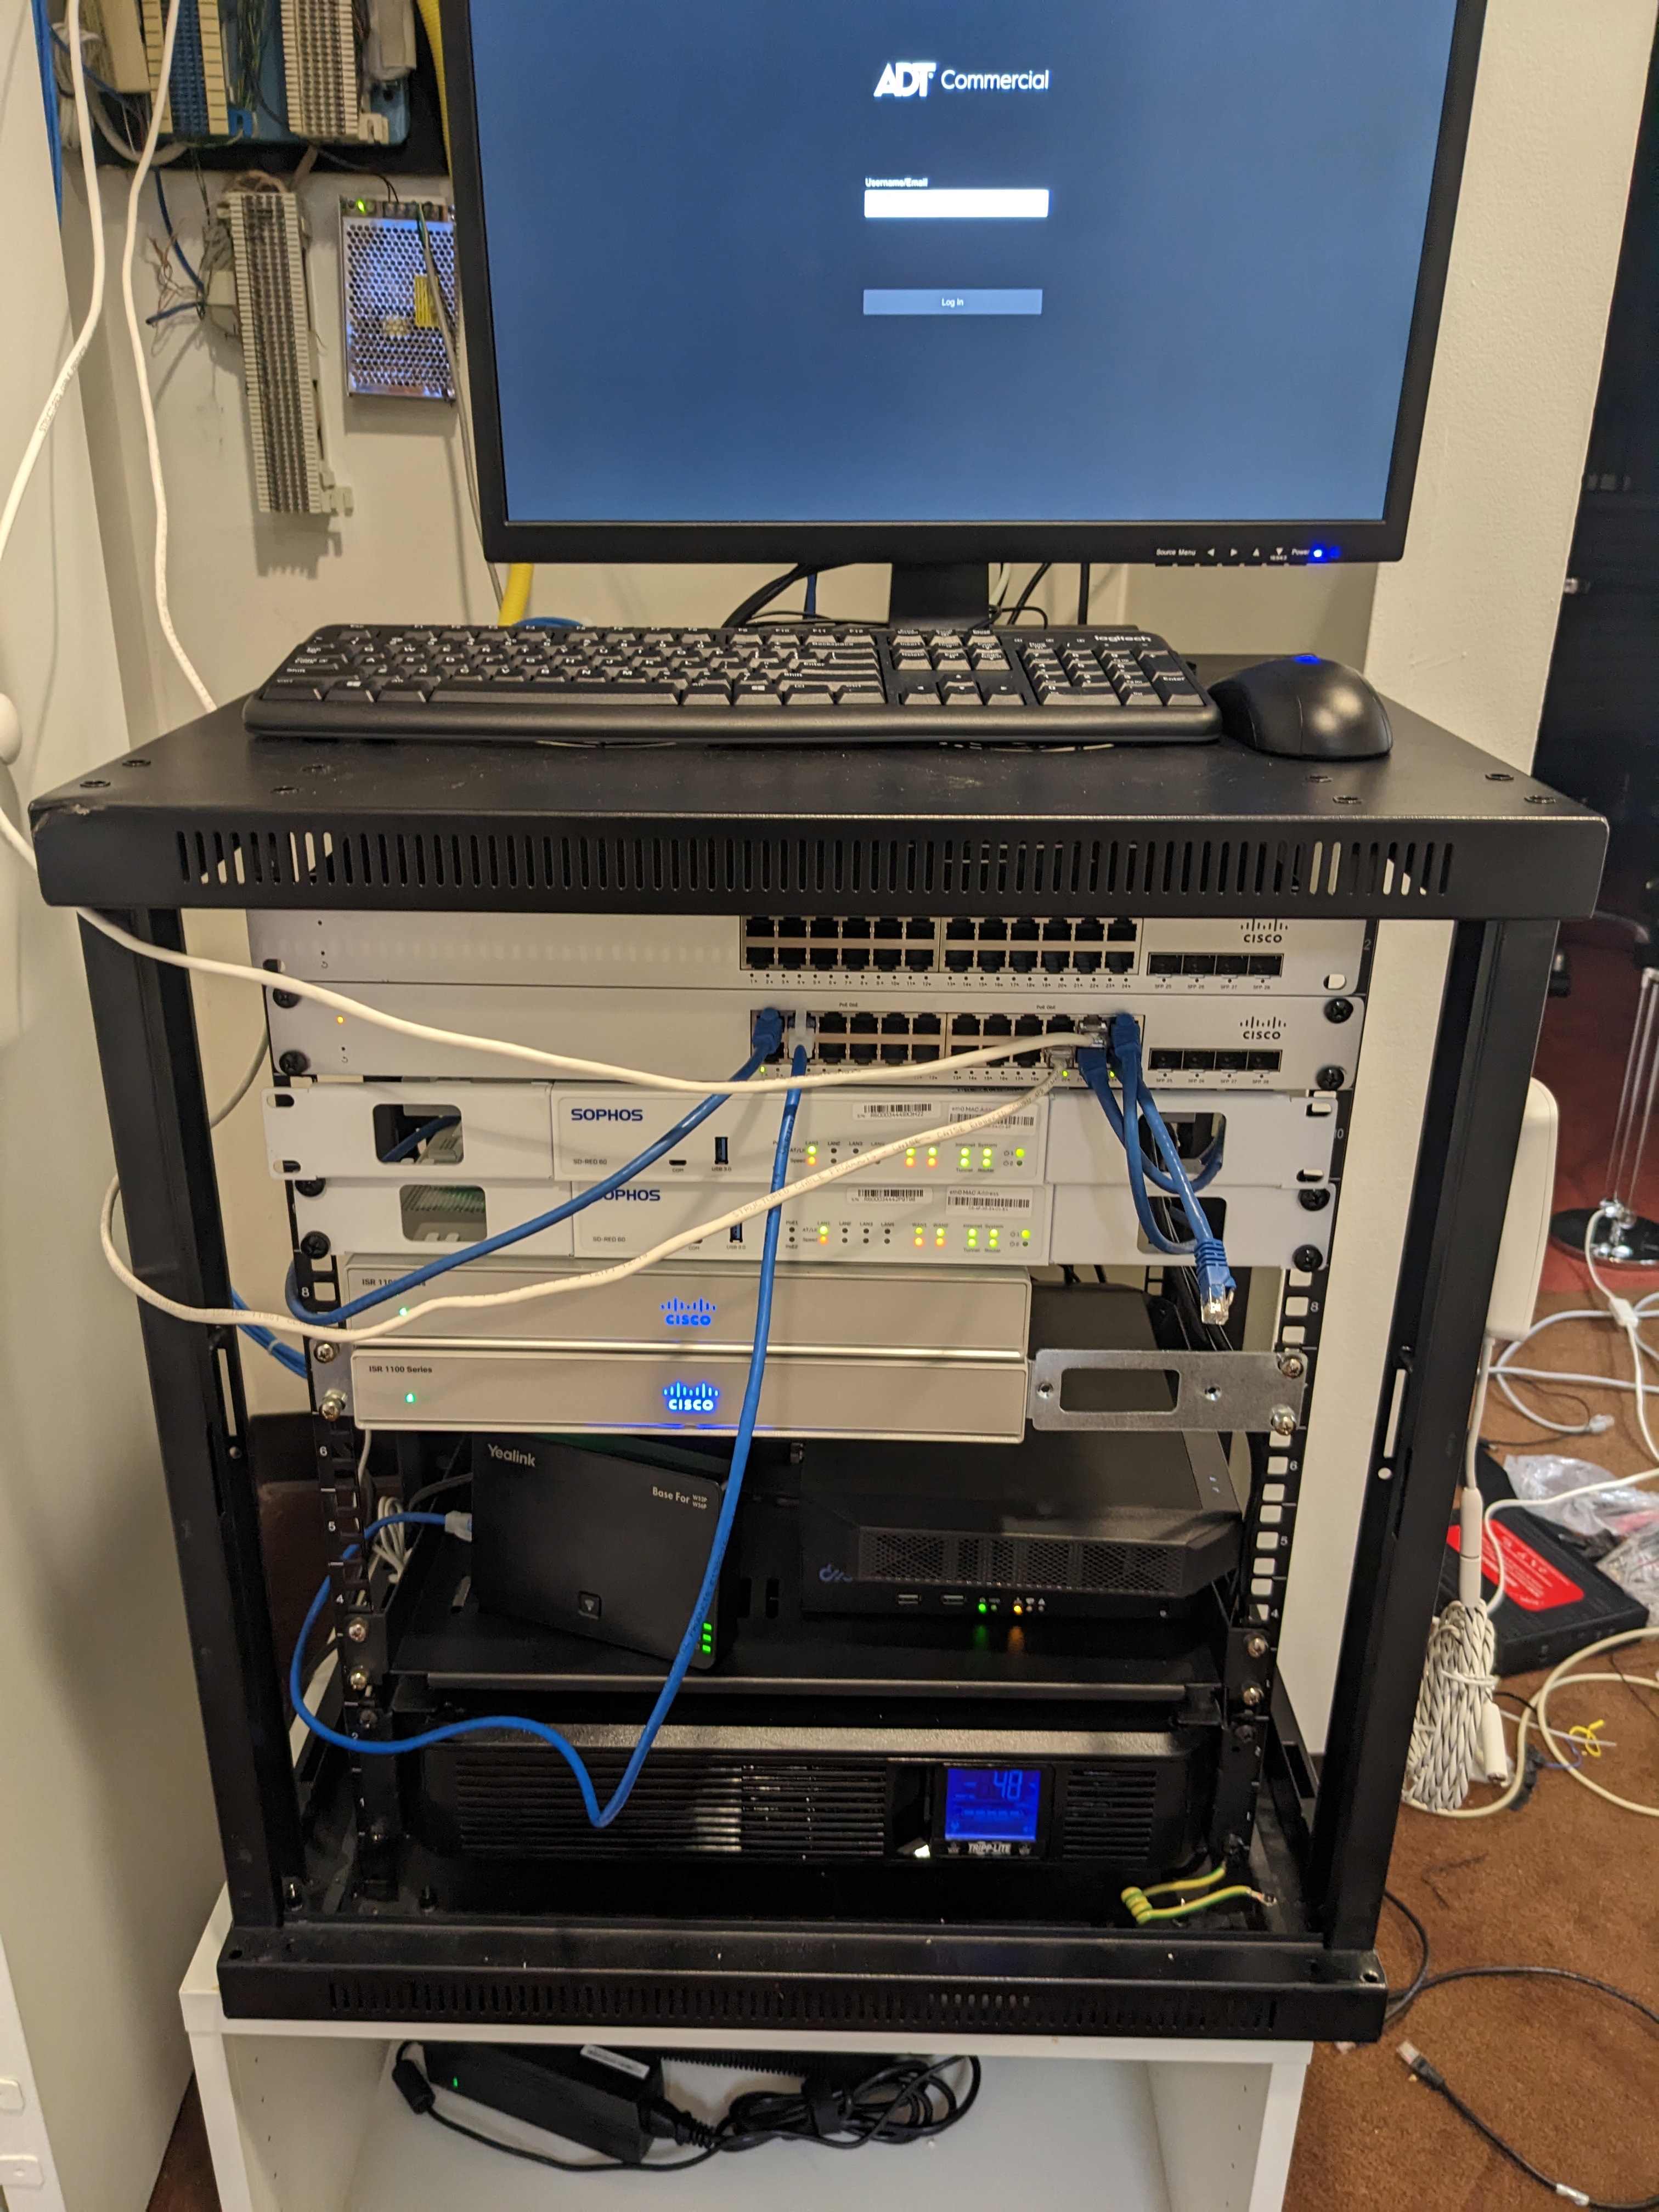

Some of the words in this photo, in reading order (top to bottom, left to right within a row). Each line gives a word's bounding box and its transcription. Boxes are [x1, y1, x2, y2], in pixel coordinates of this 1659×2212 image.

[873, 63, 936, 97] ADT
[941, 70, 1049, 90] Commercial
[865, 178, 928, 187] Username/Email
[941, 298, 955, 307] Log
[957, 298, 964, 306] In
[1094, 634, 1152, 643] logitech
[1243, 933, 1283, 944] CISCO
[1362, 939, 1372, 951] 2
[1243, 1030, 1281, 1040] CISCO
[572, 1109, 643, 1121] SOPHOS
[603, 1189, 661, 1201] OPHOS
[732, 1188, 789, 1218] STRUCTURED
[302, 1286, 310, 1298] 8
[1310, 1301, 1319, 1313] 8
[665, 1314, 712, 1326] CISCO
[668, 1398, 714, 1411] CISCO
[319, 1445, 328, 1457] 6
[488, 1443, 537, 1468] Yealink
[1289, 1460, 1298, 1471] 6
[652, 1486, 674, 1500] Base
[675, 1491, 691, 1504] For
[328, 1520, 336, 1532] 5
[1280, 1535, 1289, 1547] 5
[336, 1594, 345, 1604] 4
[1271, 1609, 1279, 1619] 4
[993, 1769, 1024, 1802] 48
